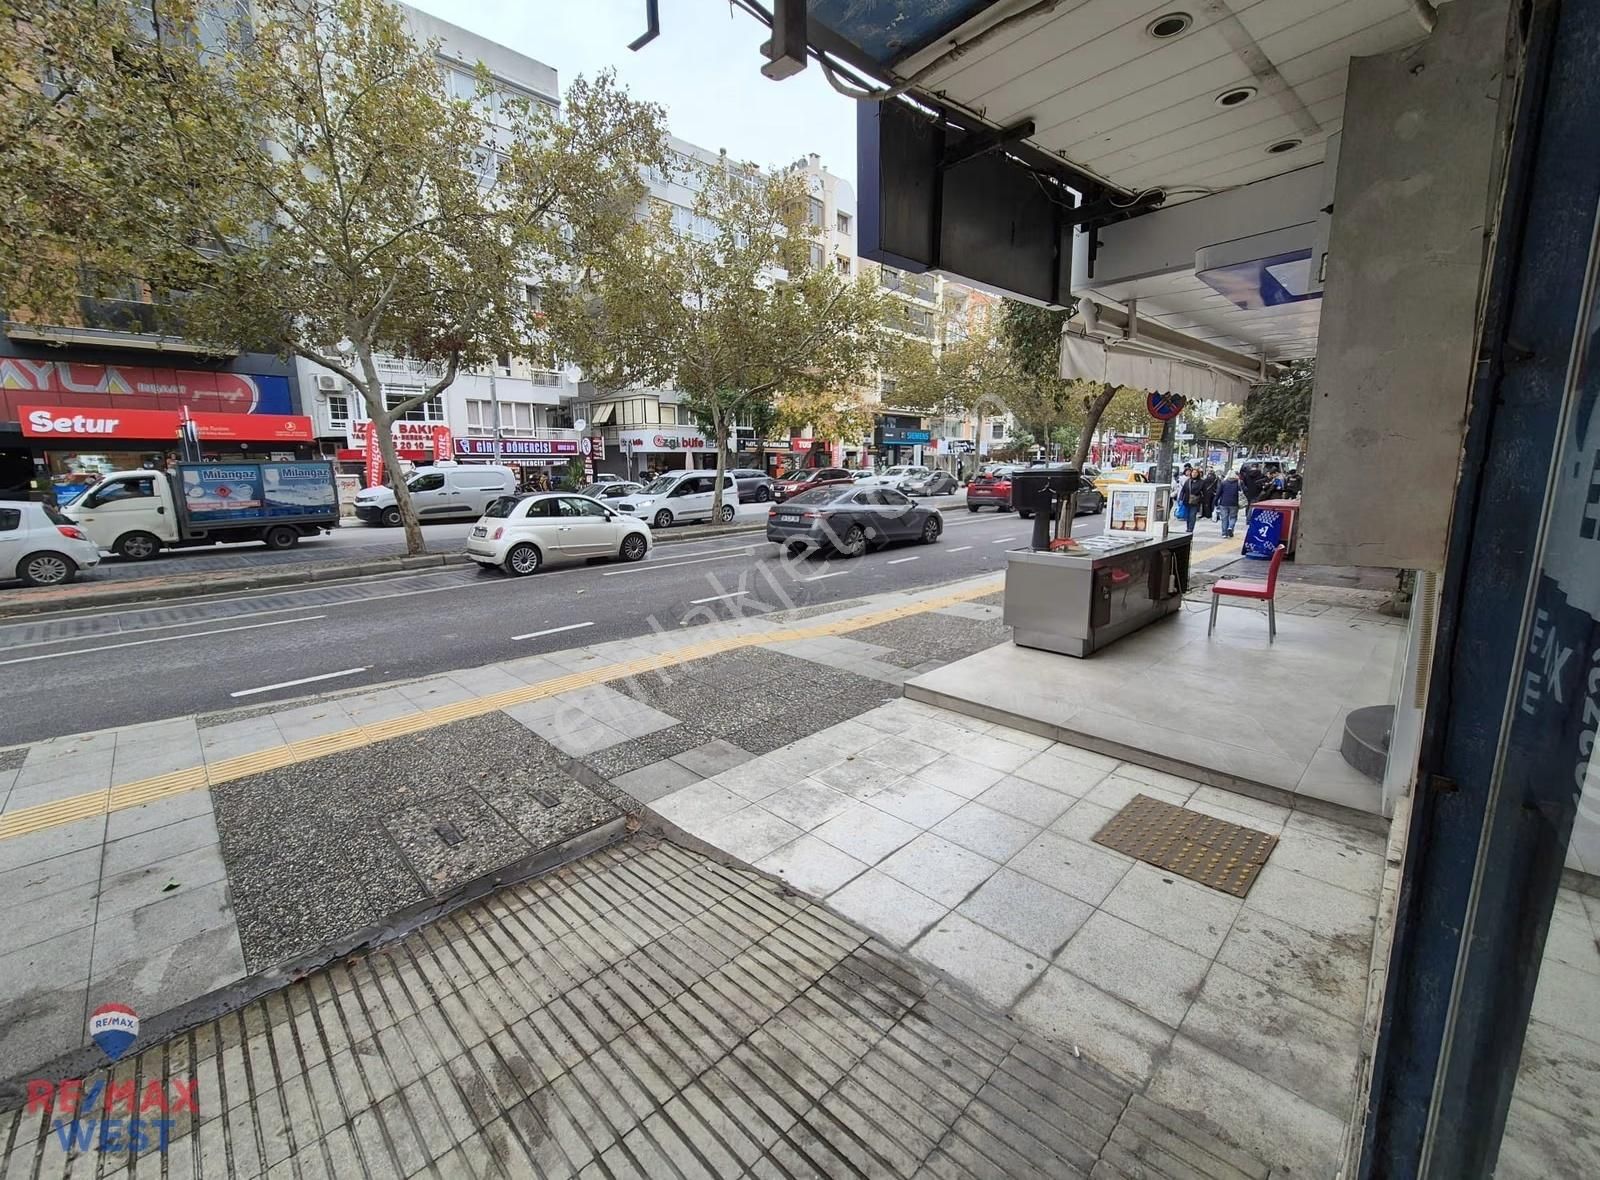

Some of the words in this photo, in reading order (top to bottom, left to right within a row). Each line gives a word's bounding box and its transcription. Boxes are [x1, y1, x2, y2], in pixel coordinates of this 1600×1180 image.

[29, 410, 119, 433] Setur
[906, 431, 929, 440] SIEMENS
[476, 441, 504, 453] GİRE
[506, 441, 552, 453] DÖNERCİSİ
[682, 437, 704, 448] büfe
[203, 468, 257, 480] Milangaz
[282, 467, 329, 479] Milangaz
